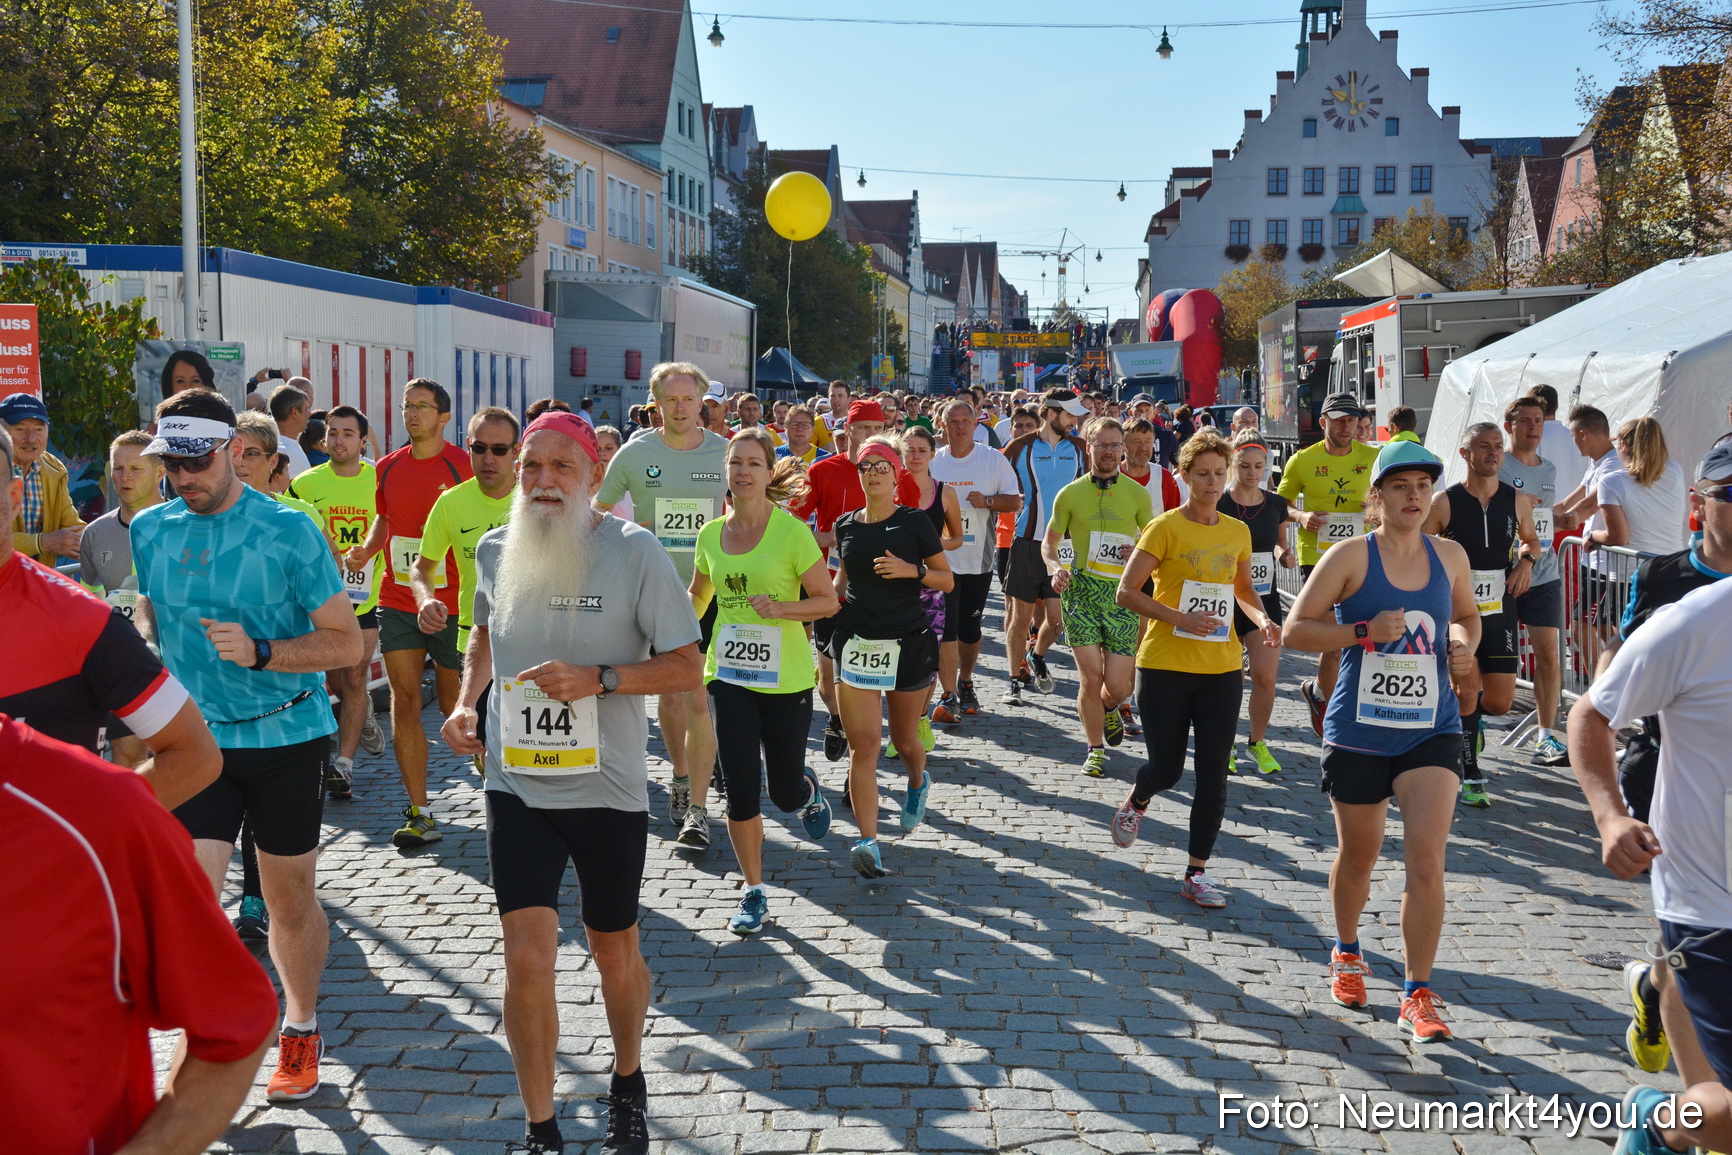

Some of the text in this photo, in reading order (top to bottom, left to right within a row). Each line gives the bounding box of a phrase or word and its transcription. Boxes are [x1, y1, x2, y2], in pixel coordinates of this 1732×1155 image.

[1003, 335, 1038, 344] START
[17, 365, 29, 374] für
[691, 472, 721, 480] BOCK
[329, 506, 368, 515] Müller
[664, 513, 704, 530] 2218
[340, 527, 359, 543] M
[1329, 524, 1354, 537] 223
[1475, 584, 1491, 597] 41
[549, 595, 602, 608] BOCK
[1188, 597, 1228, 617] 2516
[736, 630, 762, 638] BOCK
[725, 640, 770, 662] 2295
[848, 651, 890, 668] 2154
[1384, 660, 1417, 669] BOCK
[736, 670, 758, 680] Nicole
[855, 675, 879, 684] Verena
[1371, 672, 1427, 697] 2623
[1375, 697, 1392, 705] PARTL
[1374, 708, 1420, 719] Katharina
[521, 706, 572, 736] 144
[534, 753, 559, 765] Axel
